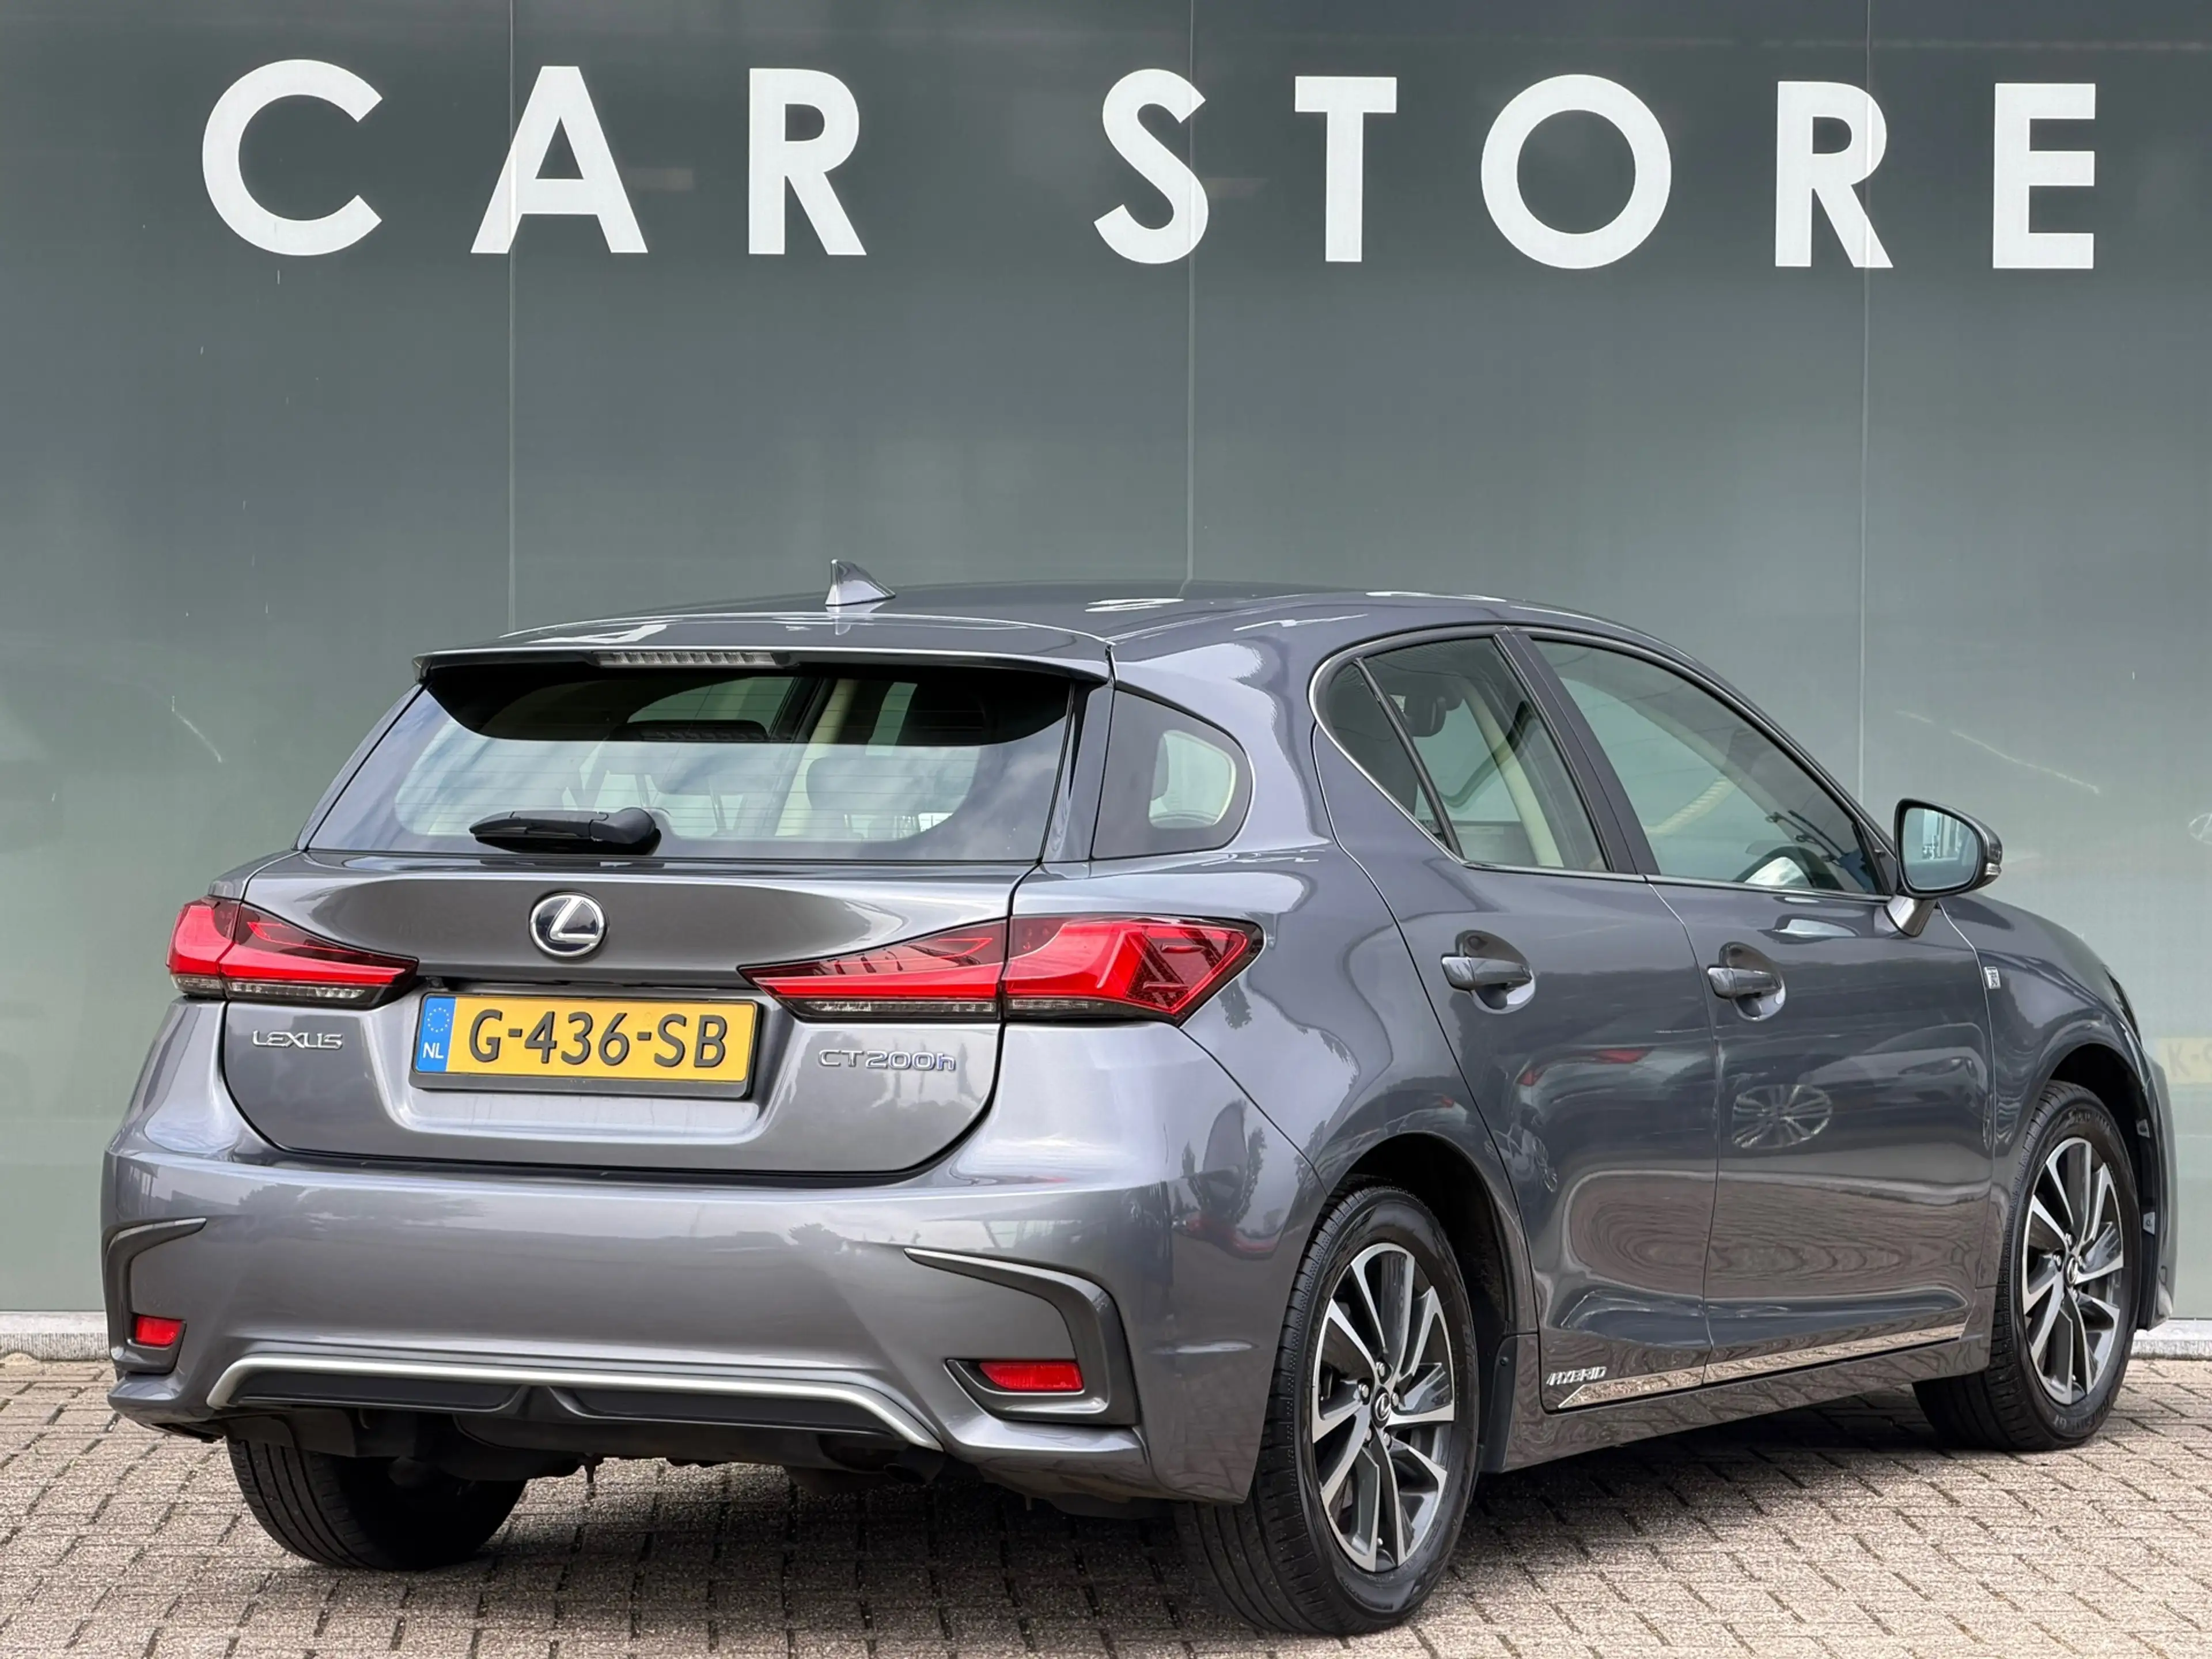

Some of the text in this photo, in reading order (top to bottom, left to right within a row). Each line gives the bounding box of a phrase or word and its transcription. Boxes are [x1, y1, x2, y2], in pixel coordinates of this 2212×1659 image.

[203, 60, 2097, 269] CAR STORE
[252, 1030, 344, 1050] LEXUS
[469, 1009, 728, 1068] G-436-SB
[422, 1042, 444, 1059] NL
[819, 1049, 957, 1070] CT200h
[1546, 1366, 1607, 1386] HYBRID
